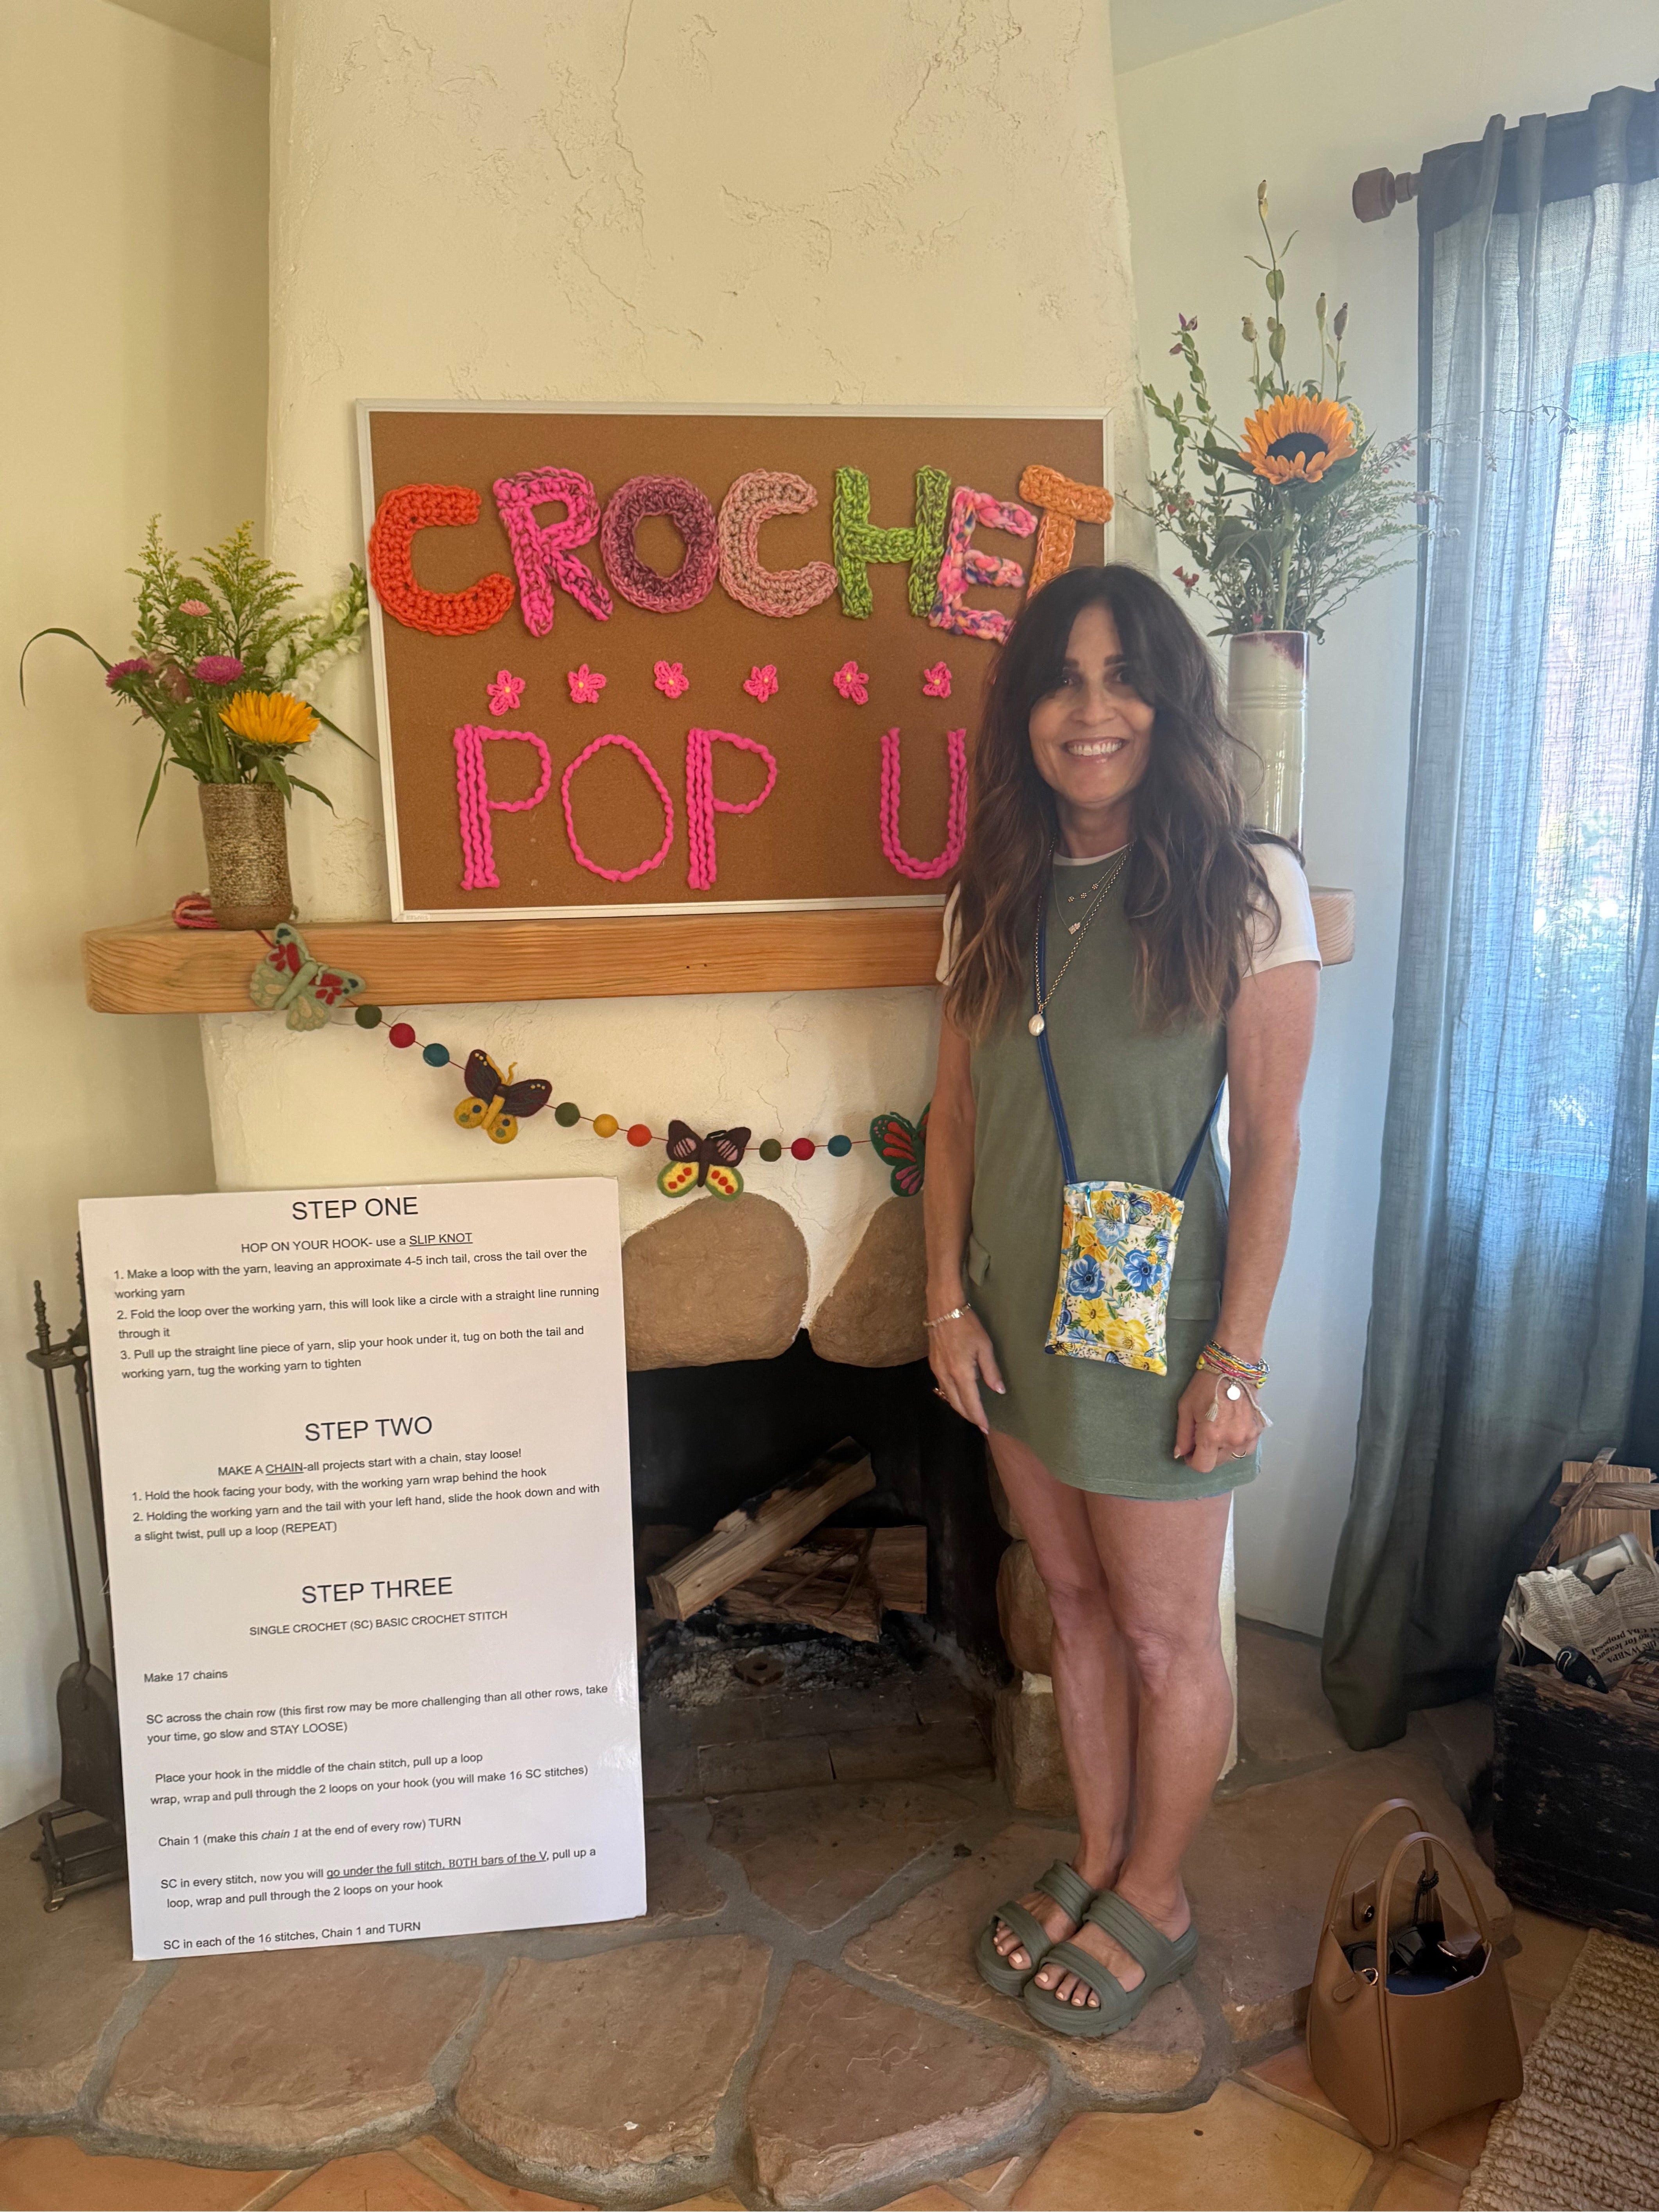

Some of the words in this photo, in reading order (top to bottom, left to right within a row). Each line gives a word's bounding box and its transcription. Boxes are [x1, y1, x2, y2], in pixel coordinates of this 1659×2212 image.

[368, 464, 1114, 645] CROCHET
[452, 724, 777, 891] POP
[292, 1199, 357, 1221] STEP
[364, 1196, 419, 1217] ONE
[240, 1242, 269, 1253] HOP
[270, 1241, 290, 1252] ON
[292, 1239, 330, 1251] YOUR
[332, 1237, 373, 1249] HOOK-
[375, 1238, 396, 1247] use
[398, 1238, 407, 1246] a
[409, 1234, 436, 1245] SLIP
[438, 1232, 473, 1243] KNOT
[114, 1270, 125, 1280] 1.
[127, 1268, 158, 1279] Make
[160, 1270, 168, 1278] a
[170, 1267, 195, 1279] loop
[197, 1266, 220, 1276] with
[222, 1265, 241, 1276] the
[242, 1265, 271, 1277] yarn,
[273, 1262, 314, 1274] leaving
[316, 1262, 331, 1271] an
[334, 1257, 402, 1272] approximate
[404, 1255, 423, 1267] 4-5
[425, 1254, 448, 1265] inch
[451, 1253, 470, 1265] tail,
[473, 1253, 503, 1263] cross
[505, 1250, 523, 1261] the
[525, 1249, 541, 1260] tail
[543, 1250, 568, 1259] over
[570, 1247, 588, 1258] the
[117, 1310, 128, 1320] 2.
[130, 1308, 155, 1319] Fold
[157, 1308, 176, 1319] the
[178, 1308, 203, 1319] loop
[204, 1307, 230, 1317] over
[231, 1305, 250, 1315] the
[251, 1302, 296, 1315] working
[297, 1302, 326, 1314] yarn,
[328, 1299, 349, 1310] this
[351, 1298, 369, 1309] will
[371, 1297, 395, 1308] look
[397, 1296, 416, 1306] like
[419, 1297, 427, 1305] a
[429, 1293, 458, 1304] circle
[460, 1292, 483, 1303] with
[495, 1289, 536, 1302] straight
[538, 1288, 557, 1298] line
[560, 1286, 599, 1298] running
[121, 1368, 165, 1380] working
[166, 1368, 195, 1379] yarn,
[197, 1366, 215, 1378] tug
[217, 1364, 236, 1375] the
[237, 1362, 281, 1374] working
[283, 1362, 308, 1374] yarn
[310, 1360, 322, 1370] to
[324, 1358, 362, 1371] tighten
[305, 1420, 369, 1442] STEP
[374, 1415, 433, 1437] TWO
[217, 1465, 253, 1476] MAKE
[254, 1464, 264, 1475] A
[265, 1461, 320, 1474] CHAIN-all
[322, 1459, 366, 1473] projects
[368, 1457, 392, 1468] start
[394, 1455, 417, 1466] with
[419, 1457, 427, 1465] a
[429, 1453, 462, 1464] chain,
[464, 1451, 488, 1463] stay
[490, 1448, 522, 1460] loose!
[134, 1533, 142, 1542] a
[144, 1530, 174, 1543] slight
[175, 1529, 204, 1540] twist,
[206, 1527, 226, 1540] pull
[228, 1528, 243, 1539] up
[245, 1528, 253, 1536] a
[255, 1525, 279, 1537] loop
[281, 1521, 337, 1536] (REPEAT)
[301, 1582, 365, 1604] STEP
[370, 1576, 453, 1600] THREE
[249, 1624, 291, 1636] SINGLE
[292, 1621, 348, 1633] CROCHET
[350, 1619, 373, 1632] (SC)
[375, 1616, 409, 1629] BASIC
[411, 1612, 465, 1626] CROCHET
[468, 1610, 509, 1622] STITCH
[1591, 1631, 1626, 1655] proposal
[1625, 1637, 1637, 1646] for
[143, 1672, 174, 1683] Make
[177, 1671, 190, 1682] 17
[192, 1669, 229, 1681] chains
[146, 1734, 172, 1746] your
[174, 1731, 201, 1742] time,
[202, 1731, 217, 1742] go
[219, 1728, 245, 1739] slow
[246, 1726, 267, 1737] and
[269, 1724, 300, 1736] STAY
[302, 1721, 348, 1734] LOOSE)
[154, 1773, 186, 1784] Place
[187, 1772, 212, 1784] your
[214, 1769, 242, 1780] hook
[243, 1768, 254, 1778] in
[256, 1767, 274, 1778] the
[276, 1764, 312, 1776] middle
[314, 1762, 325, 1774] of
[327, 1762, 345, 1772] the
[347, 1760, 376, 1771] chain
[378, 1758, 411, 1769] stitch,
[413, 1755, 432, 1769] pull
[434, 1756, 448, 1767] up
[450, 1756, 458, 1764] a
[460, 1753, 484, 1764] loop
[158, 1835, 190, 1847] Chain
[193, 1835, 199, 1845] 1
[203, 1833, 237, 1846] (make
[239, 1831, 259, 1842] this
[261, 1829, 291, 1841] chain
[293, 1828, 299, 1839] 1
[301, 1827, 312, 1838] at
[314, 1826, 332, 1837] the
[334, 1824, 355, 1835] end
[357, 1823, 369, 1833] of
[370, 1823, 400, 1833] every
[402, 1819, 427, 1832] row)
[428, 1816, 461, 1828] TURN
[167, 1898, 193, 1909] loop,
[195, 1897, 223, 1907] wrap
[225, 1893, 246, 1905] and
[248, 1891, 267, 1905] pull
[269, 1888, 311, 1902] through
[314, 1887, 331, 1898] the
[332, 1886, 341, 1896] 2
[343, 1885, 372, 1896] loops
[374, 1885, 389, 1893] on
[391, 1882, 415, 1894] your
[417, 1878, 443, 1890] hook
[163, 1939, 181, 1950] SC
[183, 1939, 193, 1949] in
[195, 1936, 222, 1948] each
[224, 1935, 236, 1946] of
[238, 1935, 255, 1945] the
[258, 1933, 272, 1943] 16
[274, 1930, 319, 1943] stitches,
[321, 1927, 353, 1939] Chain
[355, 1926, 361, 1936] 1
[365, 1924, 386, 1936] and
[387, 1921, 421, 1933] TURN
